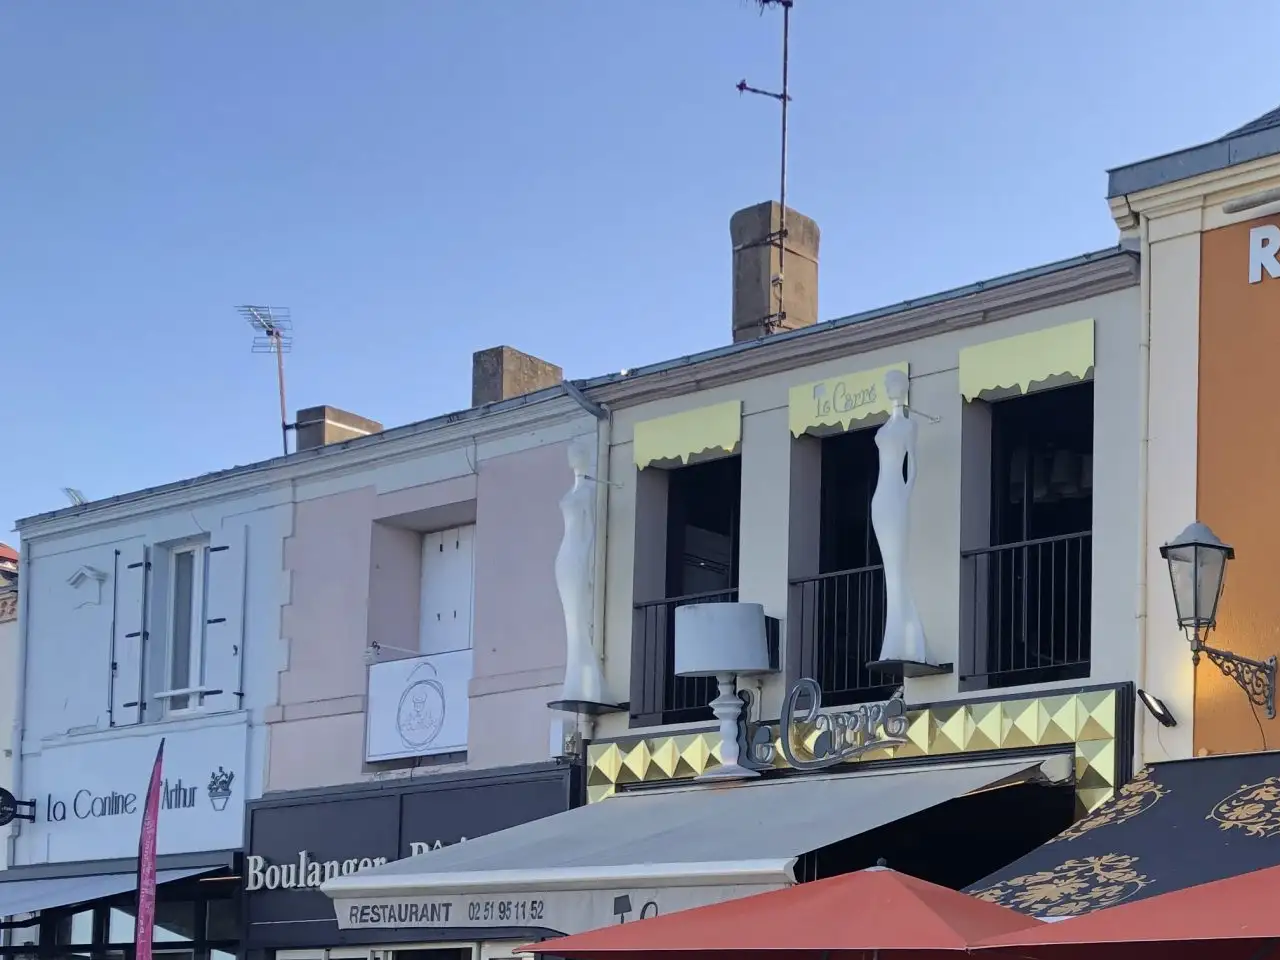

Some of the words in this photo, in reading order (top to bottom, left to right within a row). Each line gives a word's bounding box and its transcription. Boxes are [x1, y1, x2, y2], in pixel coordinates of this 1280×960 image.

[833, 381, 877, 413] Carré
[780, 677, 908, 770] Carré
[73, 789, 137, 819] Cantine
[159, 778, 199, 810] 'Arthur
[350, 902, 453, 924] RESTAURANT
[468, 902, 481, 921] 02
[484, 902, 495, 920] 51
[499, 901, 512, 919] 95
[515, 902, 526, 920] 11
[531, 900, 544, 919] 52
